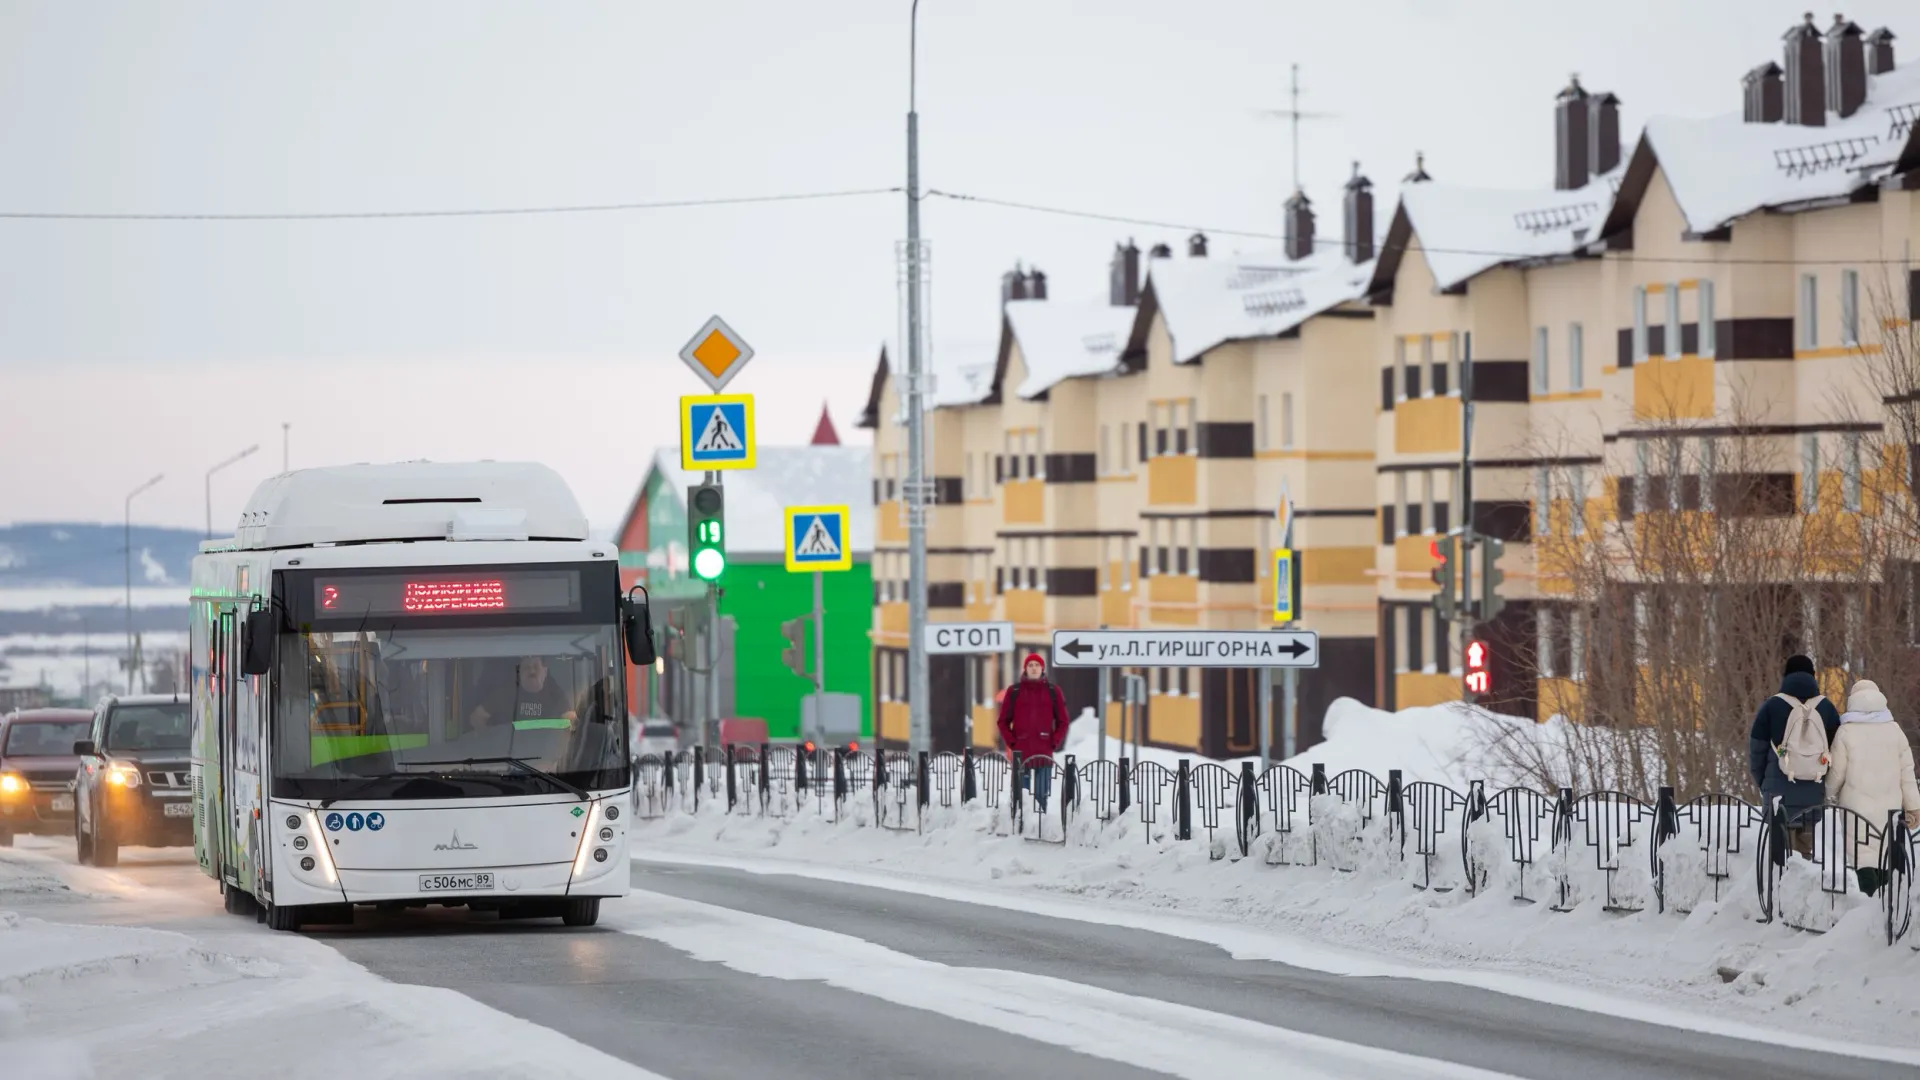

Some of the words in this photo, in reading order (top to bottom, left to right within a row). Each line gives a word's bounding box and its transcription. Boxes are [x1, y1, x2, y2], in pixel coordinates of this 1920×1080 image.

[700, 521, 721, 543] 19
[324, 587, 338, 609] 2
[407, 582, 502, 596] Поликлиника
[937, 628, 1000, 647] СТОП
[1098, 640, 1273, 660] ул.Л.ГИРШГОРНА
